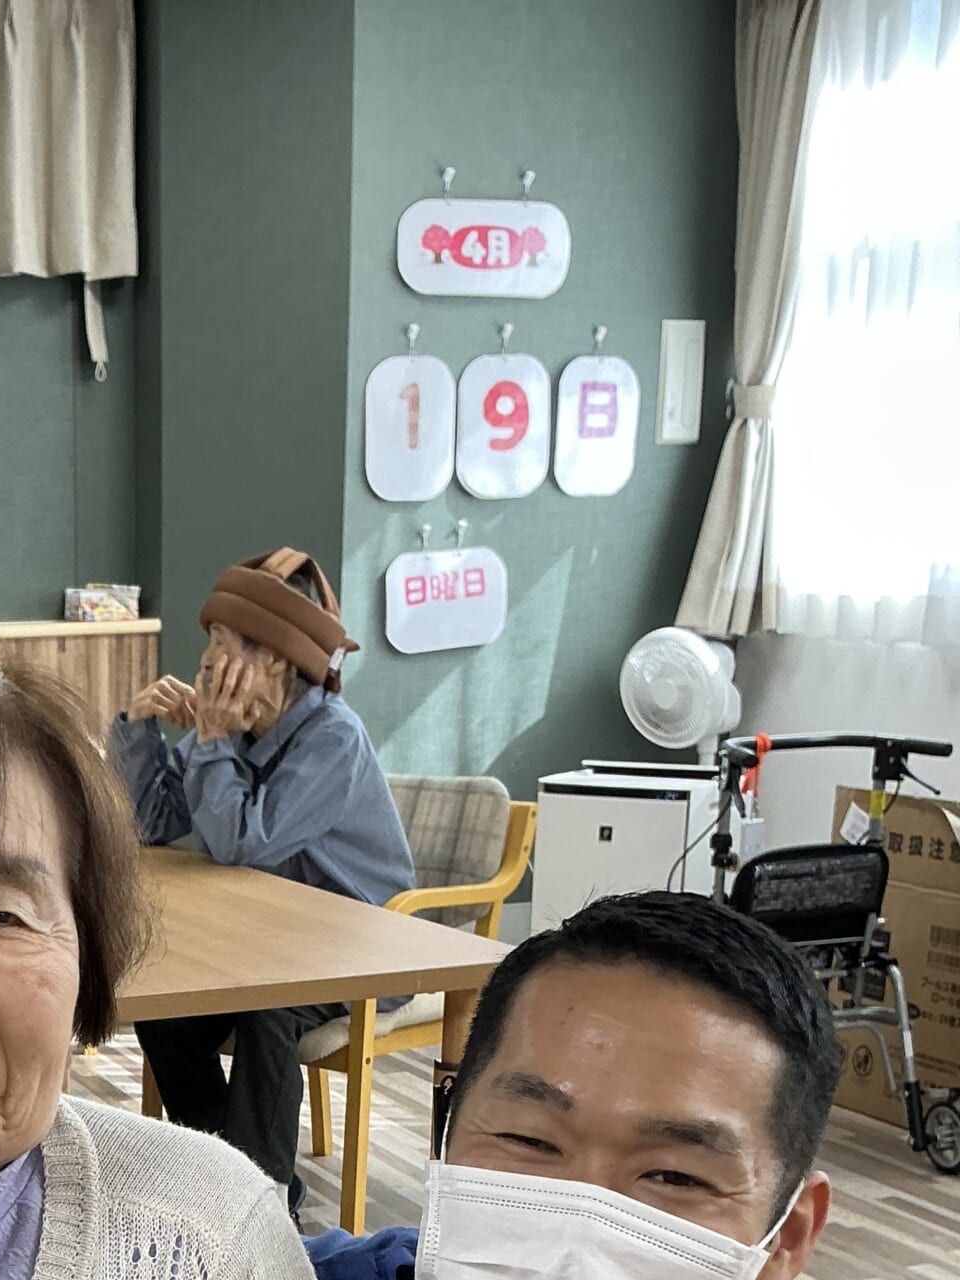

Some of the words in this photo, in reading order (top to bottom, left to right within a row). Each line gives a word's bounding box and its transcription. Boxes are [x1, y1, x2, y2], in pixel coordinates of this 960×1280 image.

[461, 229, 510, 265] 4月
[405, 567, 486, 607] 日曜日
